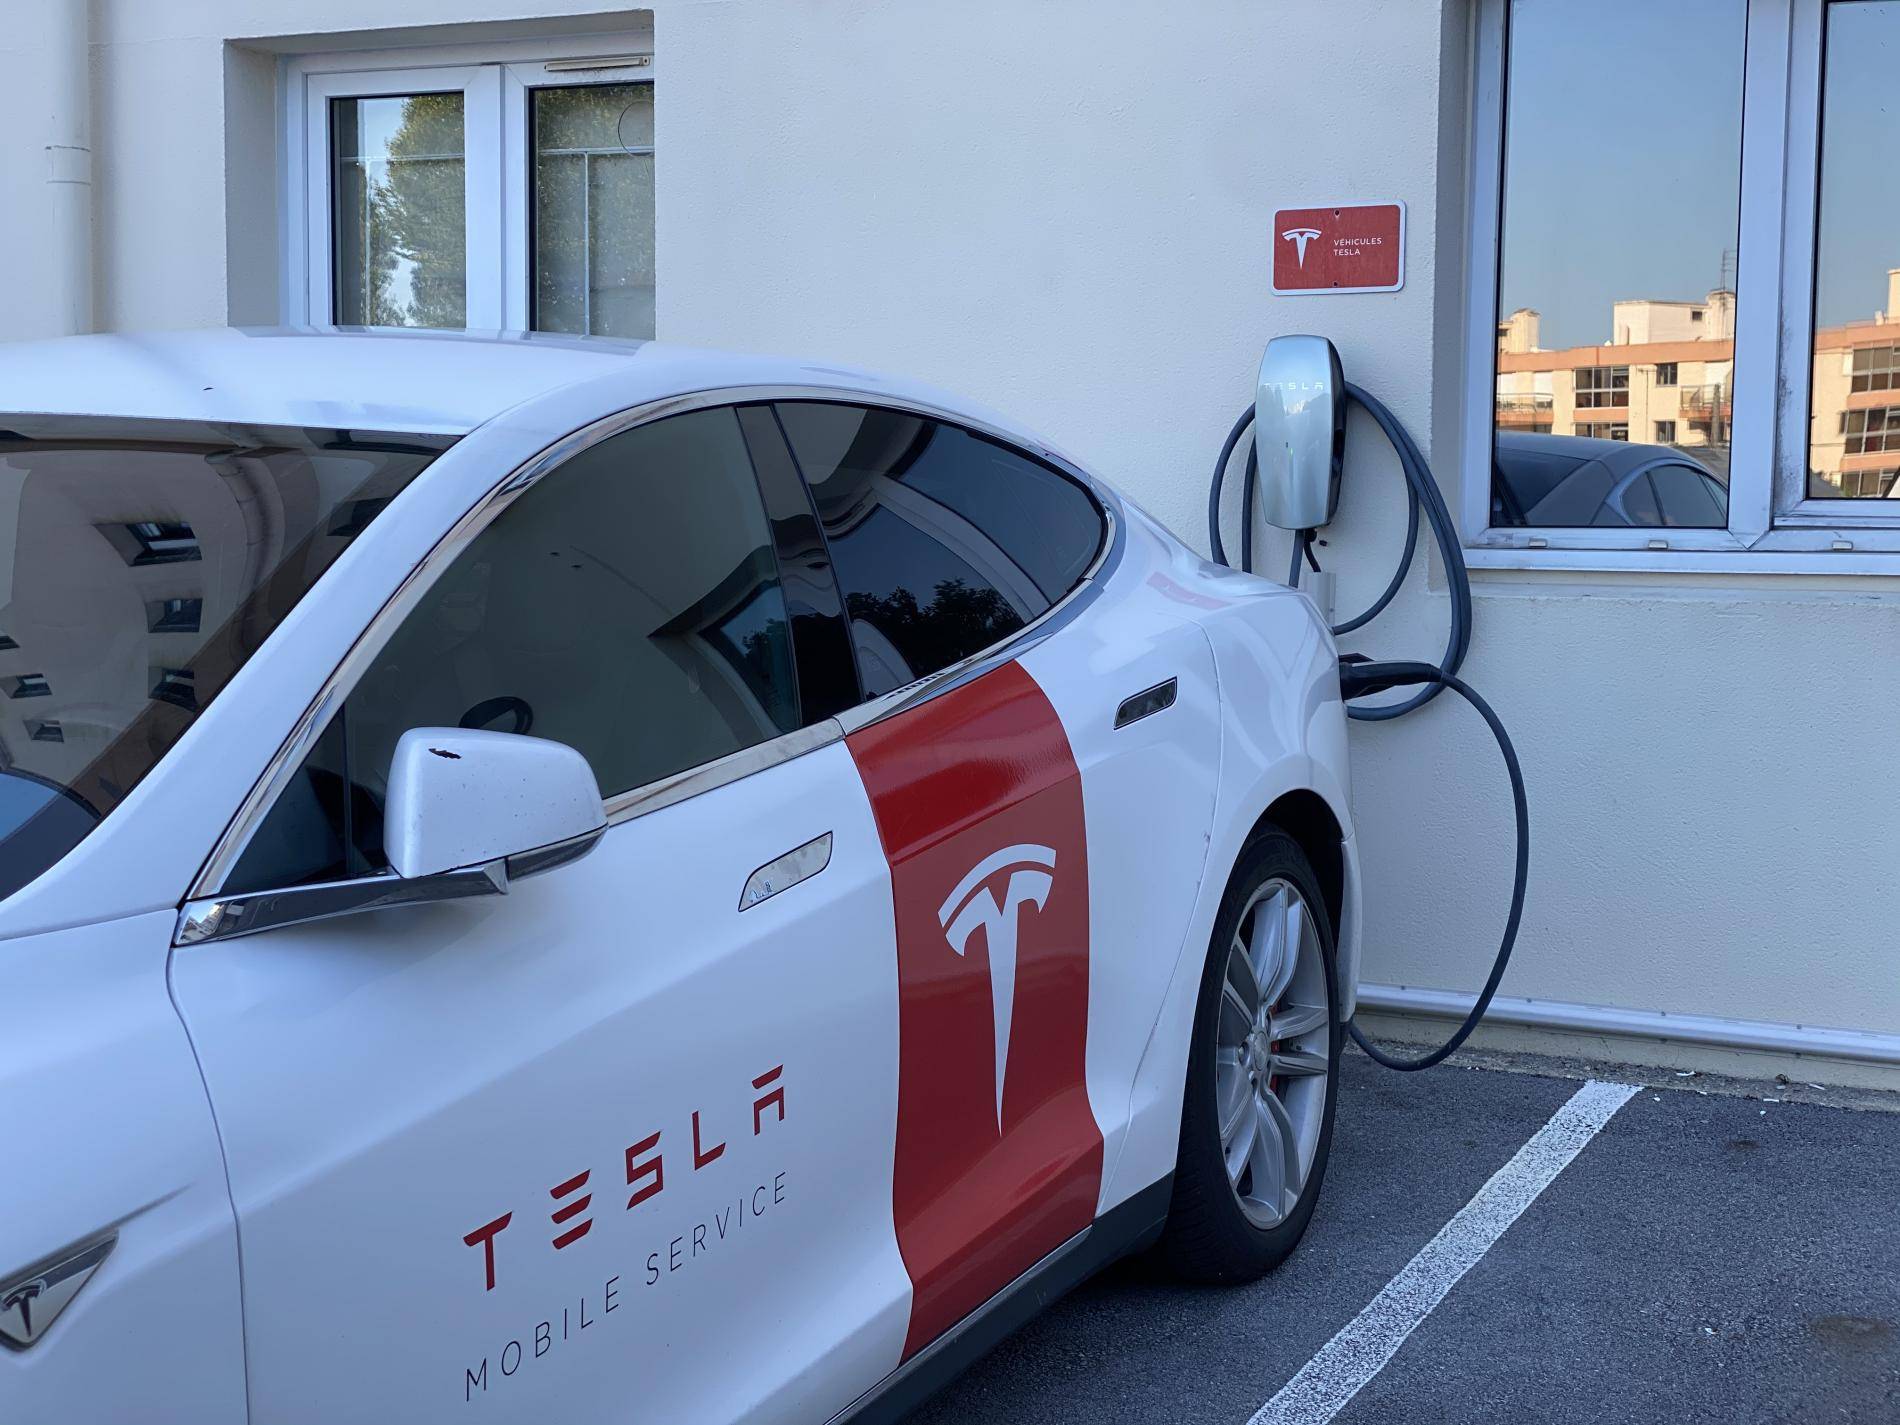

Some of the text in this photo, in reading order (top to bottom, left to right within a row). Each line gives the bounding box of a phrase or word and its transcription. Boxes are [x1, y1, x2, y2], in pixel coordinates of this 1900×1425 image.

[1333, 248, 1361, 256] TESLA
[463, 1064, 785, 1291] TESLA
[466, 1171, 787, 1402] MOBILE SERVICE
